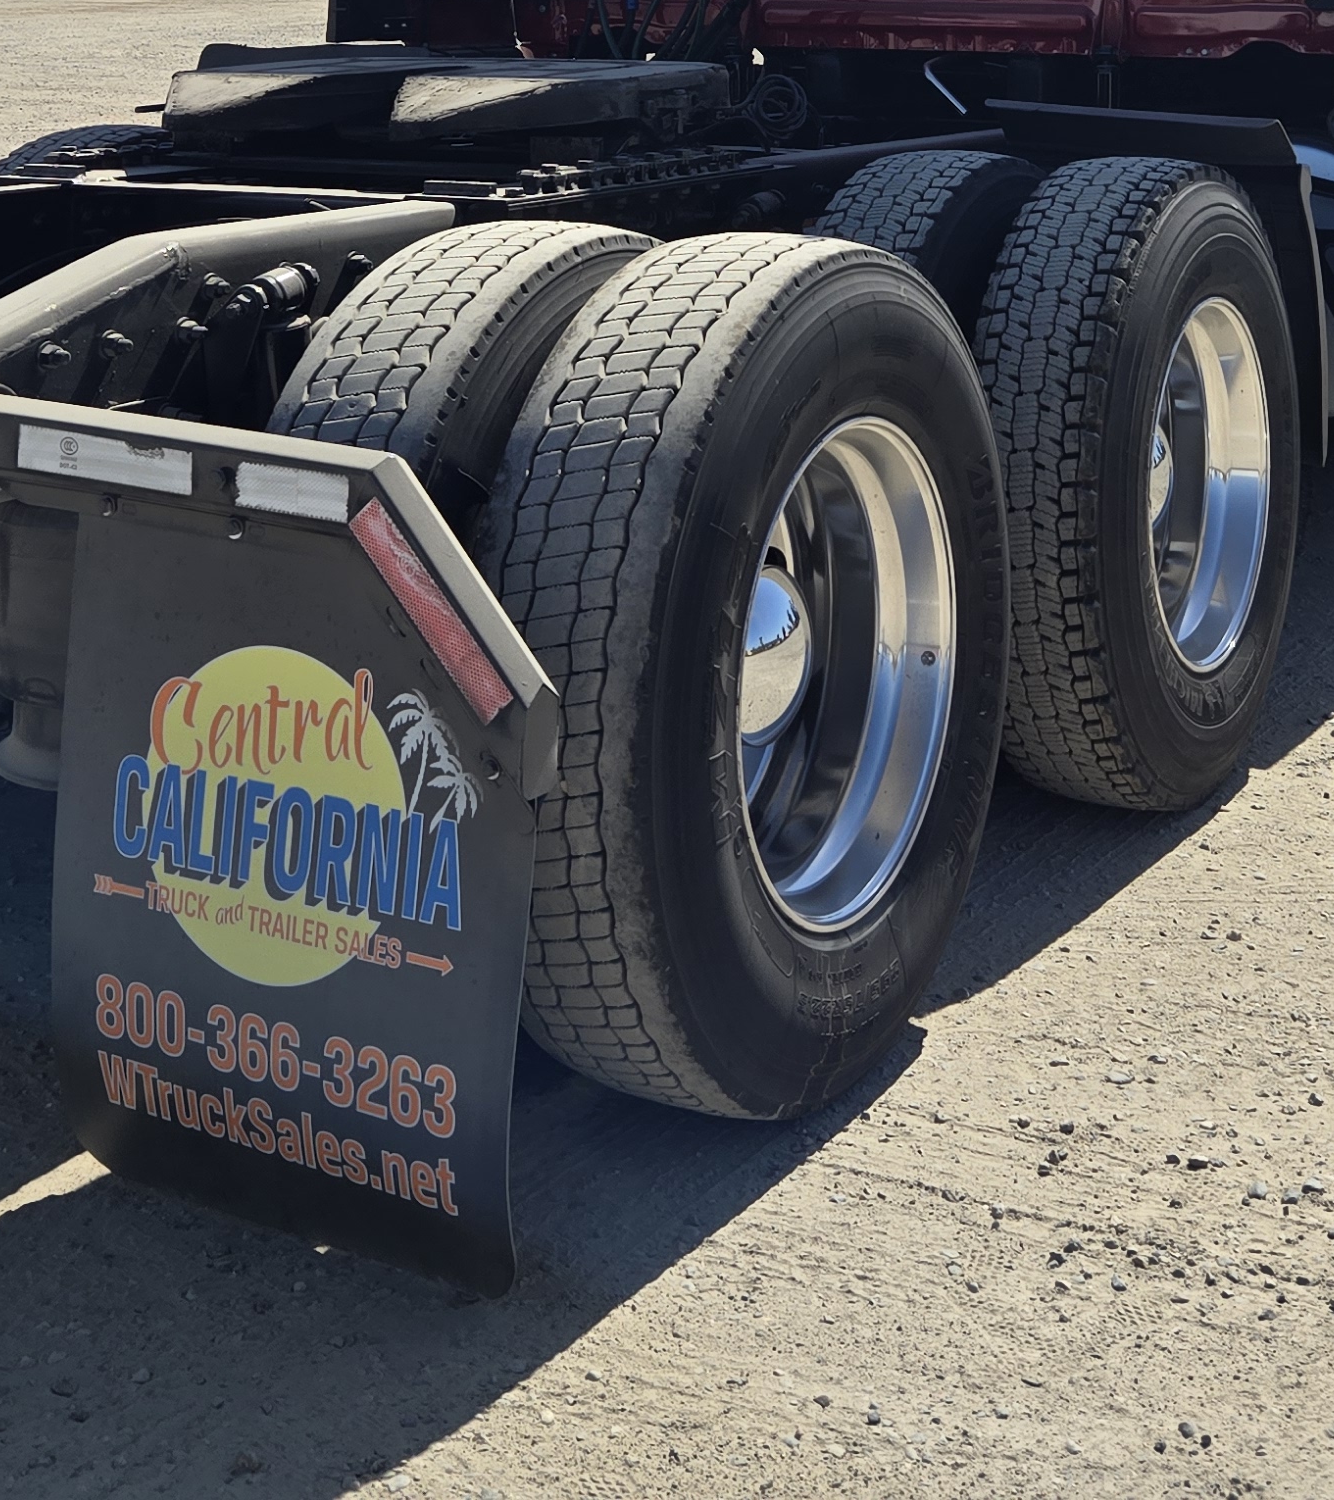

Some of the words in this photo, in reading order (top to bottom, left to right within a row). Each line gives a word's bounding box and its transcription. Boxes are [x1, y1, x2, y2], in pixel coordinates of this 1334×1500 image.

[150, 668, 374, 776] Central
[112, 753, 463, 932] CALIFORNIA
[145, 880, 210, 922] TRUCK
[215, 894, 245, 926] and
[247, 905, 329, 951] TRAILER
[333, 926, 402, 969] SALES
[94, 973, 457, 1140] 800-366-3263
[96, 1049, 460, 1218] WTruckSales.net
